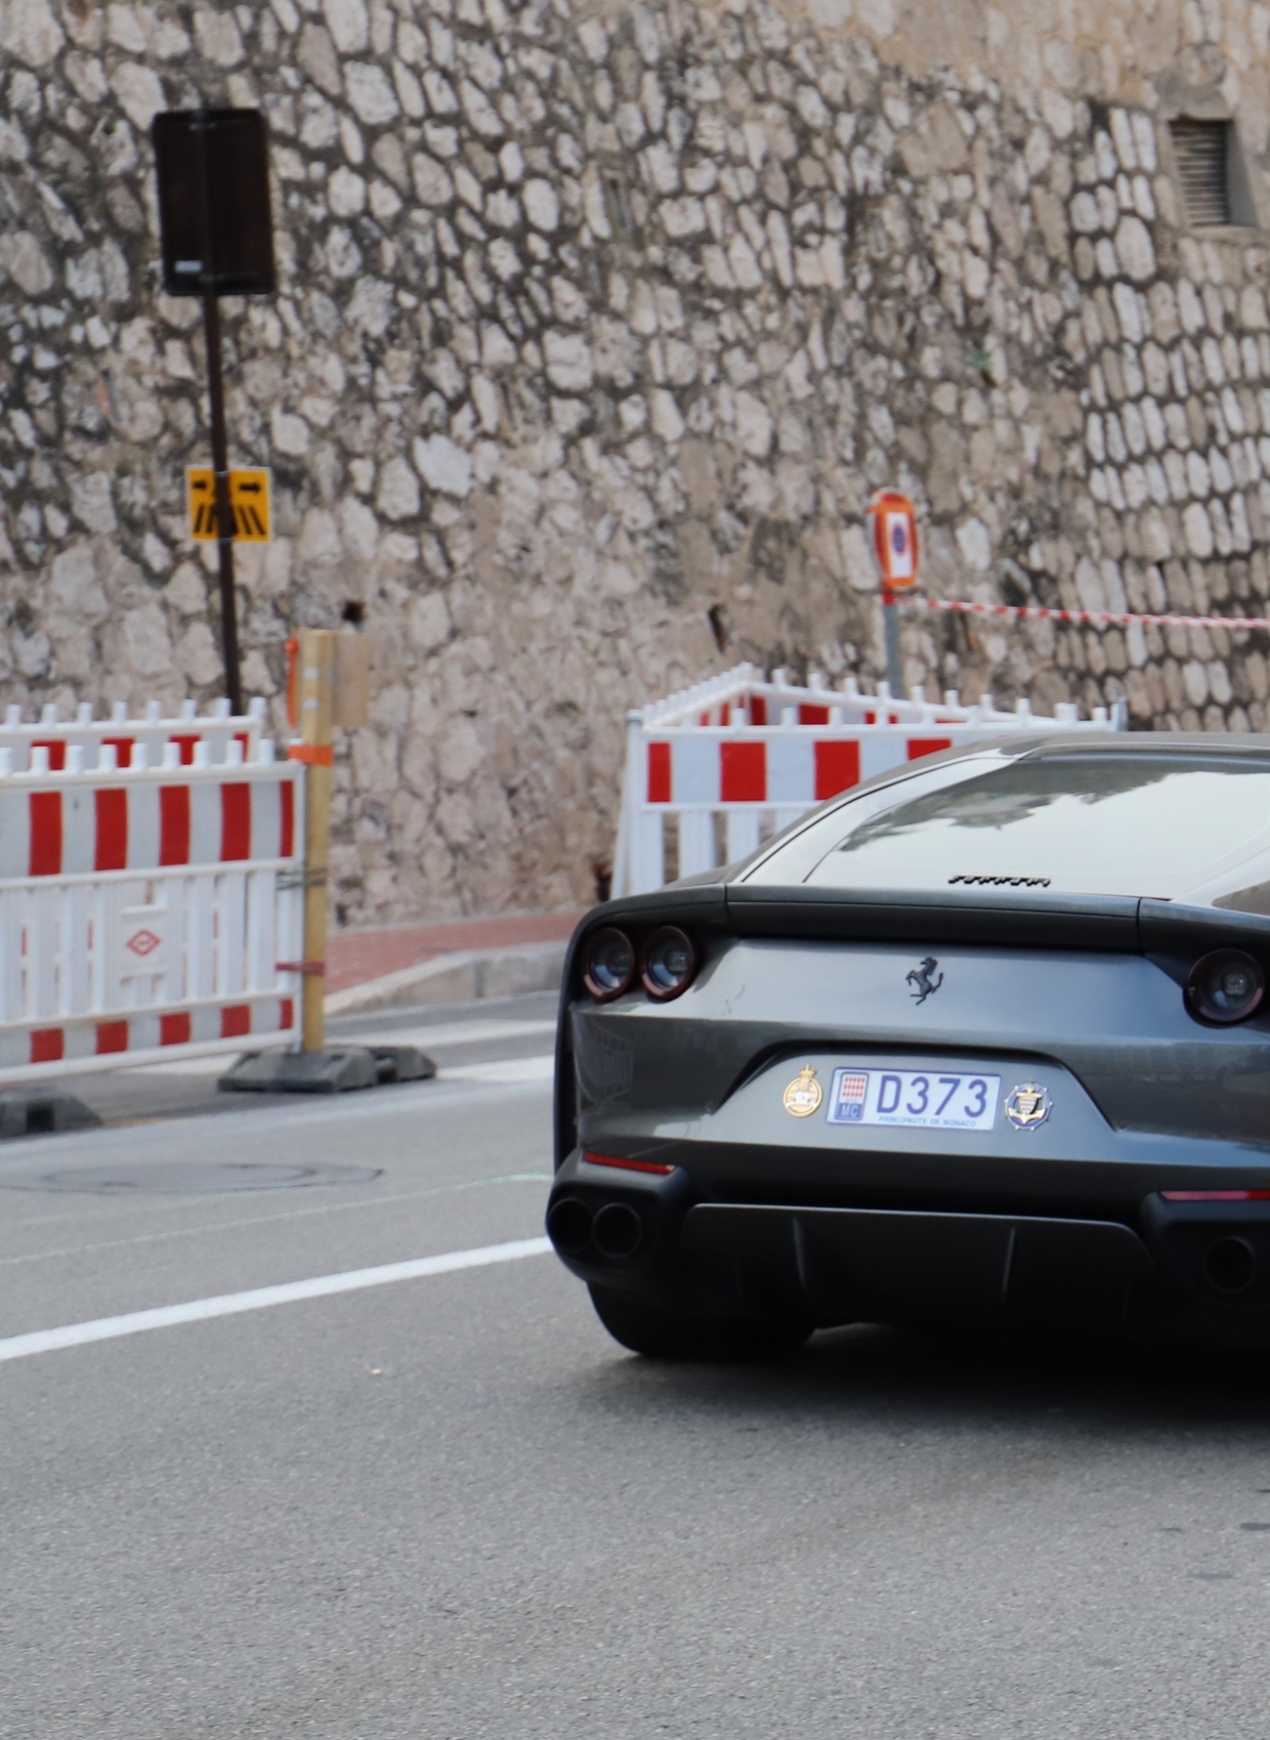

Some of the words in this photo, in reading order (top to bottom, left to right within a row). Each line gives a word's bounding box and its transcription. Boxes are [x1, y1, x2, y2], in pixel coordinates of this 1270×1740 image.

[877, 1075, 987, 1118] D373
[841, 1105, 859, 1118] MC
[930, 1118, 940, 1126] DE
[943, 1118, 977, 1128] MONACO
